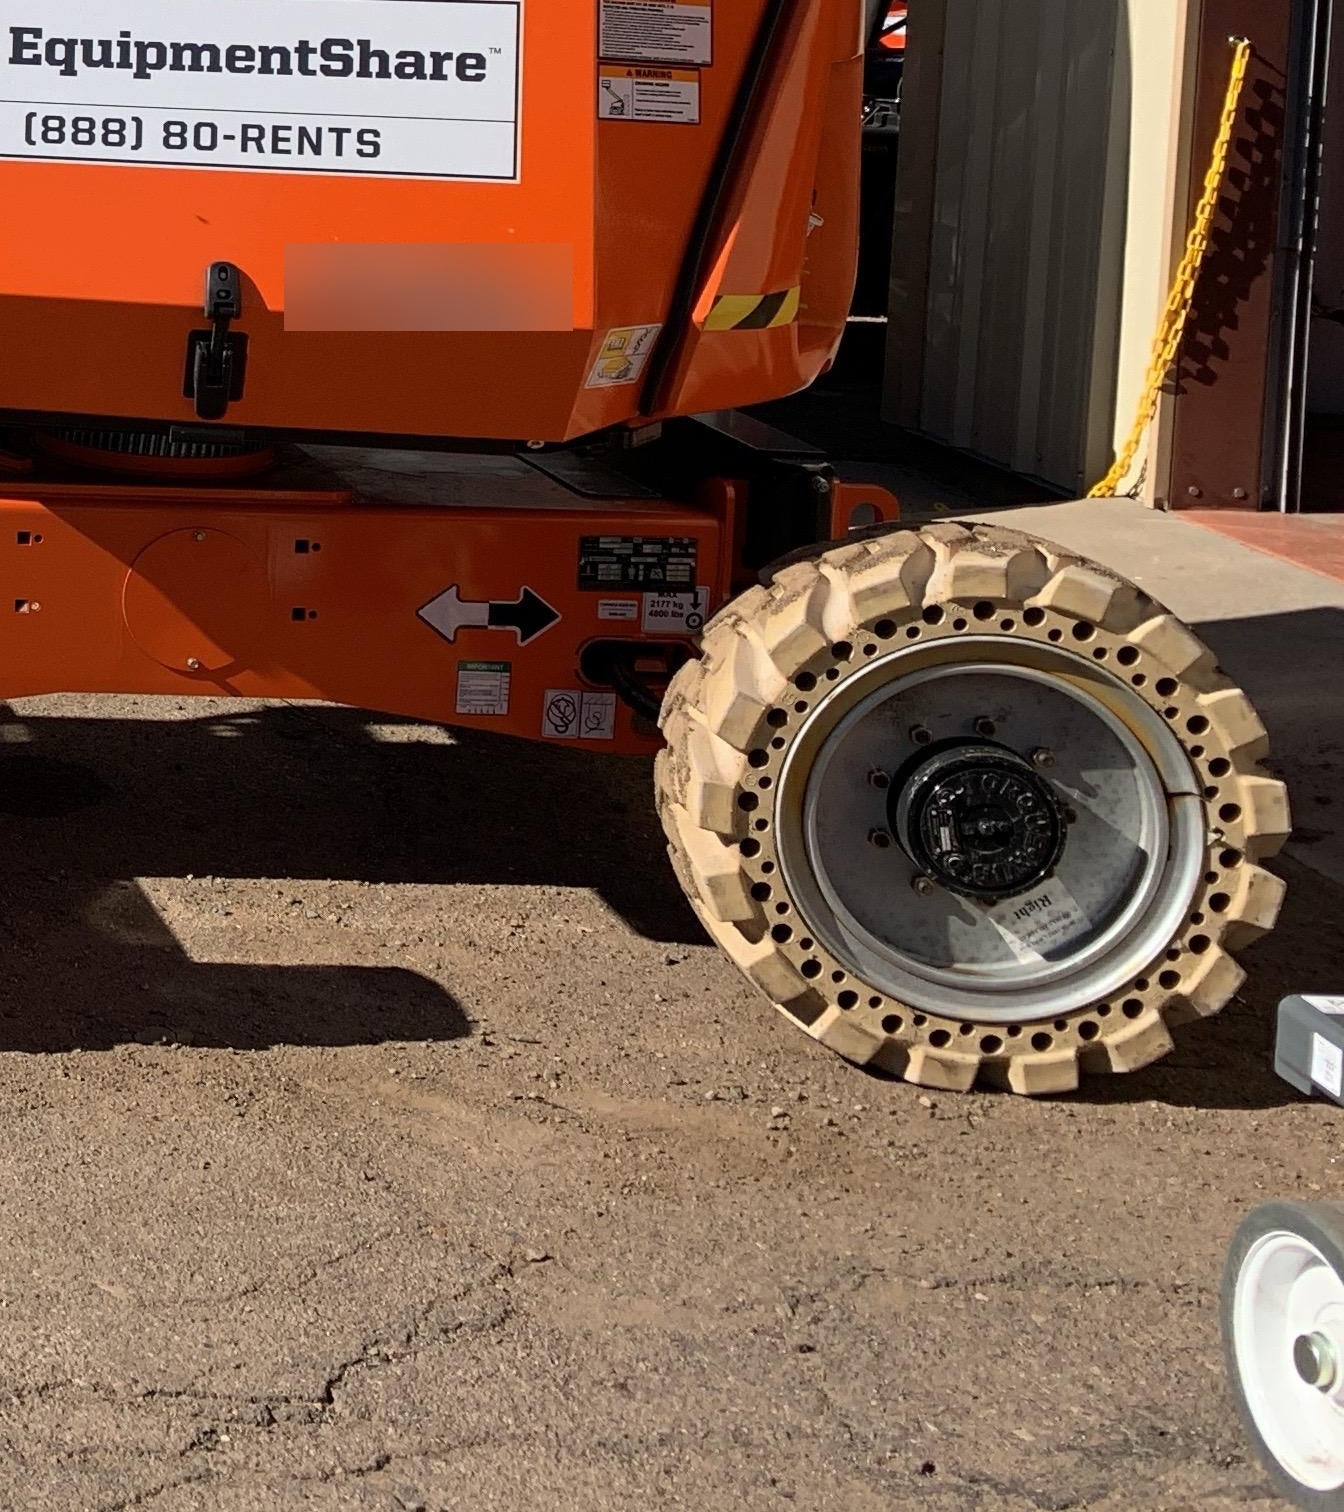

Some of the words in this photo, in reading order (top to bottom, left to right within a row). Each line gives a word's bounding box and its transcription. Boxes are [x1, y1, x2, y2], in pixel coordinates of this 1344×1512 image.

[635, 69, 672, 79] WARNING
[24, 111, 143, 150] (888)
[162, 120, 381, 158] 80-RENTS
[650, 600, 670, 608] 2177
[1013, 894, 1052, 920] Right
